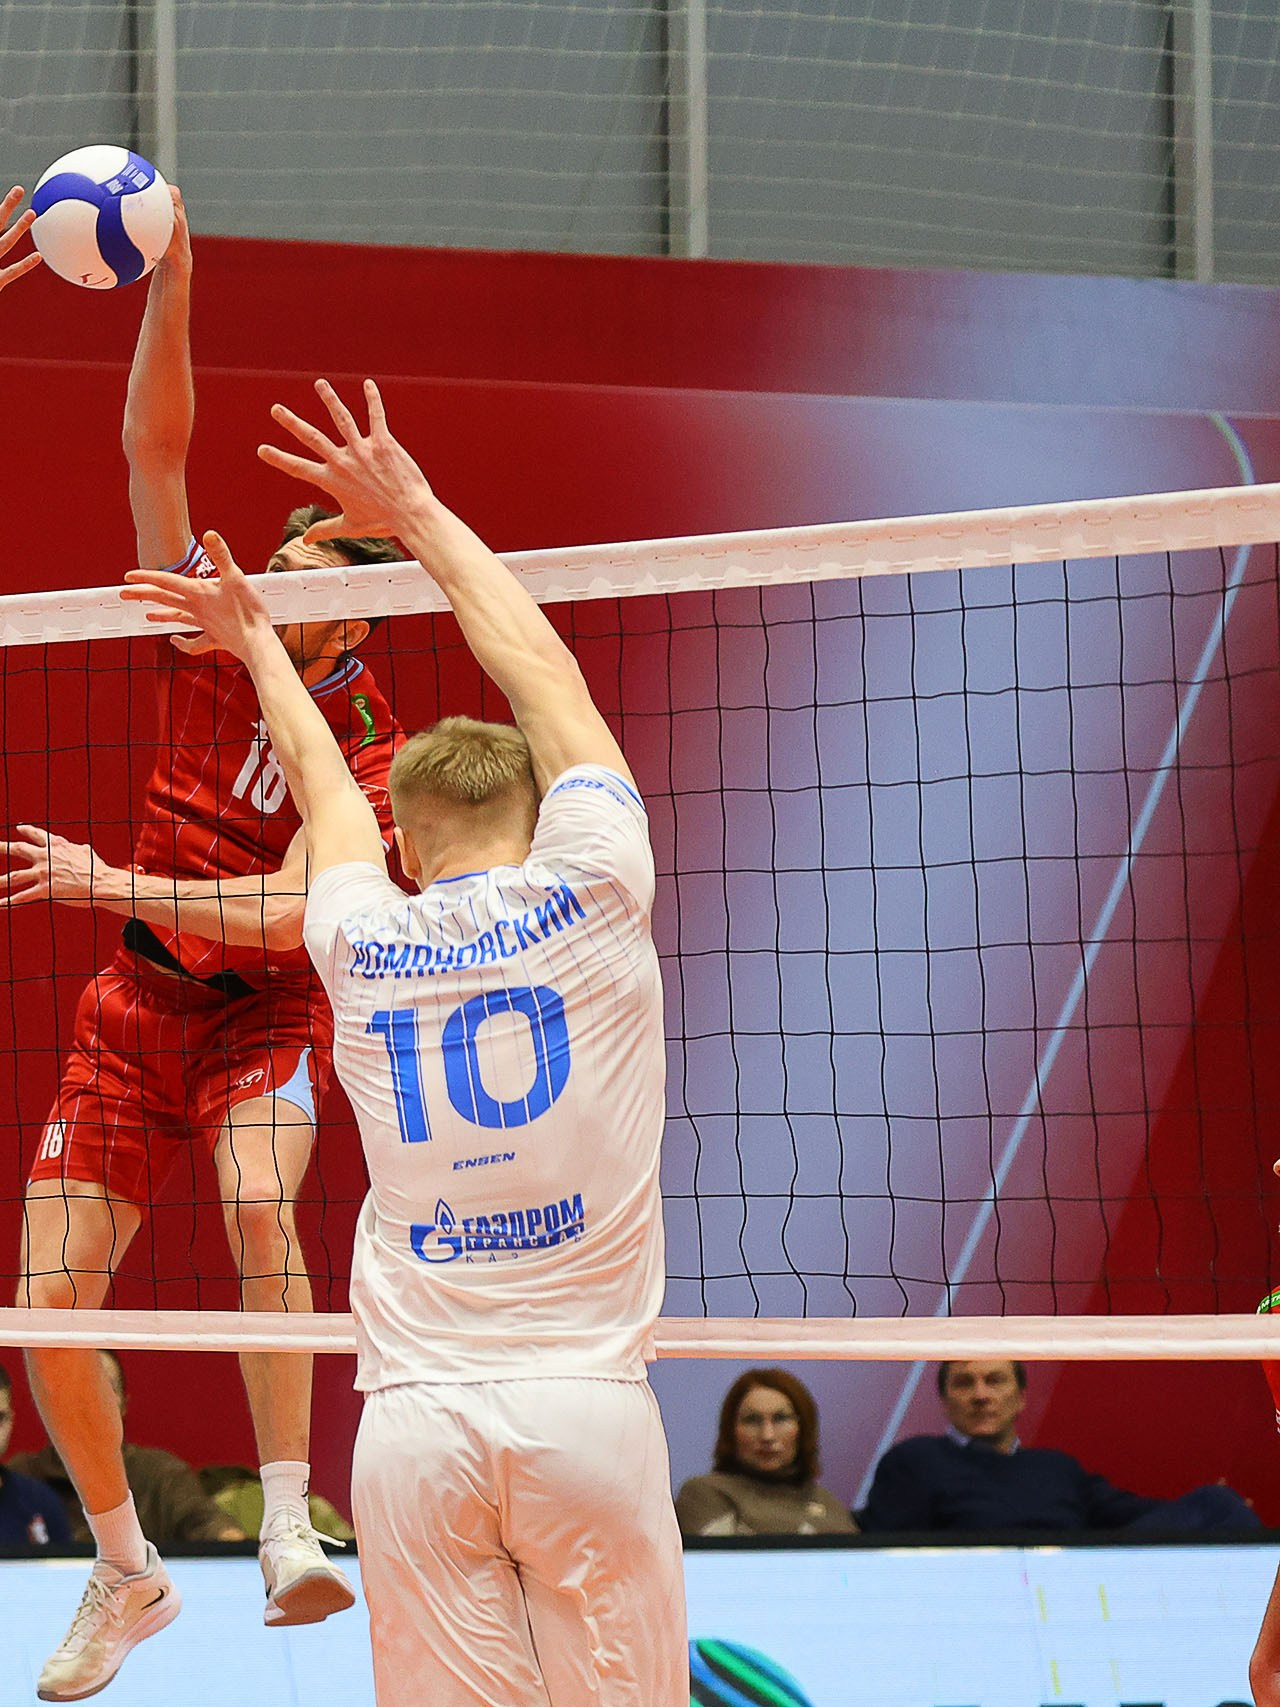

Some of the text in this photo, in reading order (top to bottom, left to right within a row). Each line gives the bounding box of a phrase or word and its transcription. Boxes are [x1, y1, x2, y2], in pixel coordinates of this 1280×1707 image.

[350, 884, 587, 980] РОМАНОВСКИЙ
[365, 985, 571, 1144] 10
[40, 1118, 67, 1161] 18
[462, 1193, 585, 1238] ГАЗПРОМ
